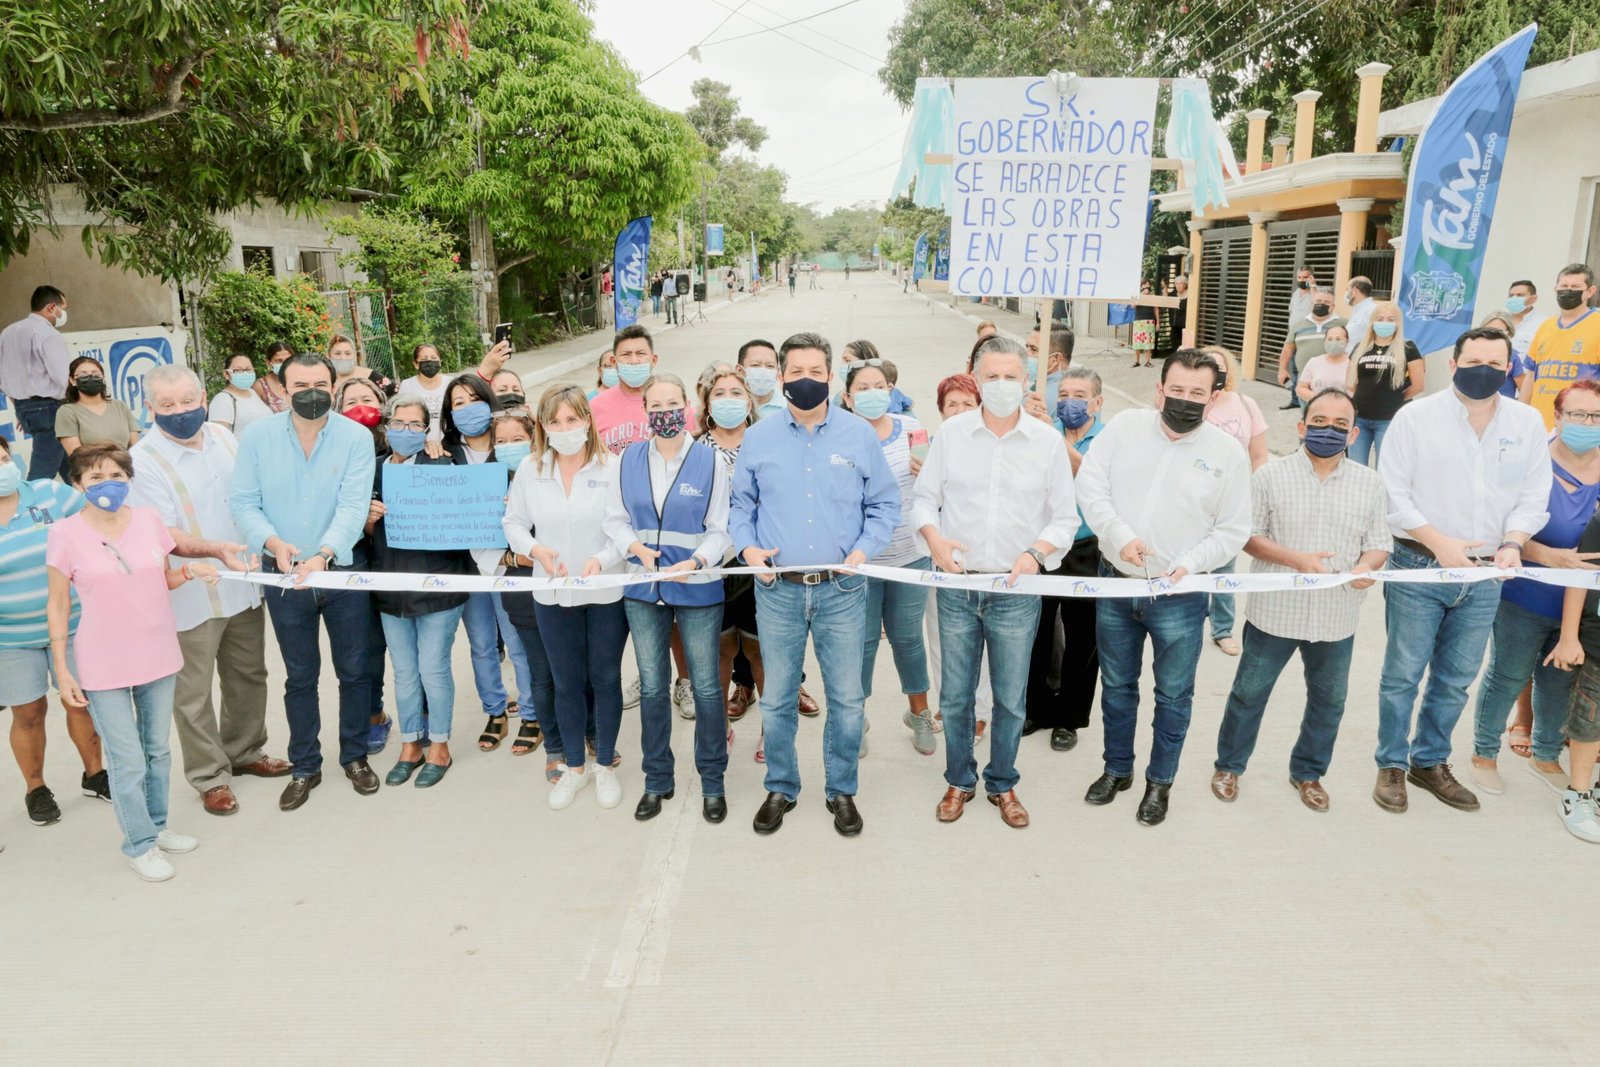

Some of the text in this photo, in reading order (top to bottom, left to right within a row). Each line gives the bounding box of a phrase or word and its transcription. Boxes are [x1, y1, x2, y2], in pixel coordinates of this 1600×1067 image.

[957, 119, 1148, 156] GOBERNADOR
[954, 161, 1128, 194] SE AGRADECE
[1422, 132, 1481, 256] Tam
[1468, 132, 1497, 241] GOBIERNO DEL ESTADO
[963, 197, 1123, 229] LAS OBRAS
[967, 232, 1102, 263] EN ESTA
